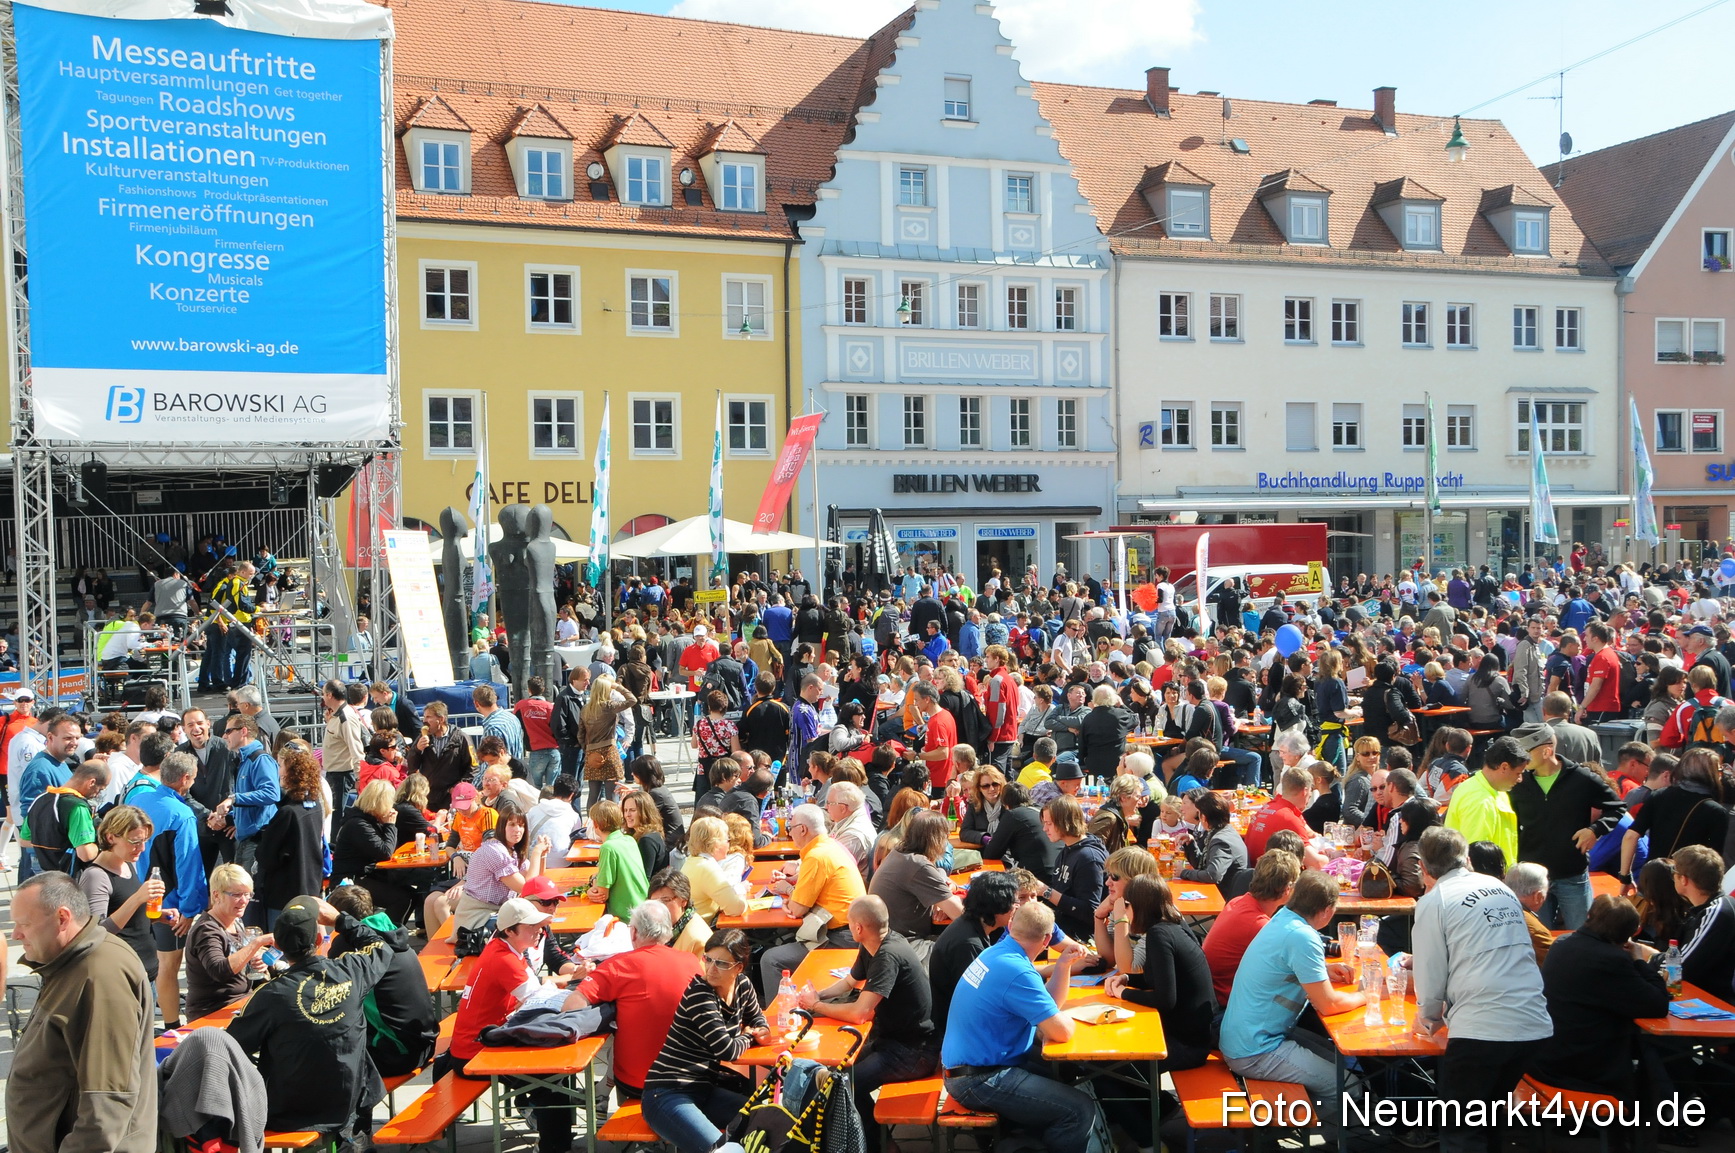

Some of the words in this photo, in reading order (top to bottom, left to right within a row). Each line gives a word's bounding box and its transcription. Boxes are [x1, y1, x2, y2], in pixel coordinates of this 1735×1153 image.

[92, 35, 316, 81] Messeauftritte
[59, 61, 269, 96] Hauptversammlungen
[274, 87, 293, 98] Get
[296, 88, 343, 102] together
[95, 91, 154, 106] Tagungen
[159, 92, 295, 121] Roadshows
[86, 110, 327, 148] Sportveranstaltungen
[63, 132, 256, 167] Installationen
[260, 156, 350, 171] TV-Produktionen
[86, 163, 269, 188] Kulturveranstaltungen
[118, 184, 197, 198] Fashionshows
[204, 190, 328, 206] Produktpräsentationen
[99, 198, 314, 229] Firmeneröffnungen
[129, 222, 218, 236] Firmenjubiläum
[215, 239, 284, 252] Firmenfeiern
[135, 244, 270, 273] Kongresse
[208, 273, 263, 286] Musicals
[150, 283, 250, 303] Konzerte
[176, 303, 237, 314] Tourservice
[131, 338, 299, 357] www.barowski-ag.de
[908, 351, 971, 369] BRILLEN
[973, 353, 1030, 370] WEBER
[154, 393, 284, 413] BAROWSKI
[292, 395, 327, 413] AG
[154, 415, 229, 424] Veranstaltungs-
[232, 415, 251, 423] und
[254, 415, 326, 424] Mediensysteme
[1139, 424, 1153, 446] R
[893, 474, 968, 493] BRILLEN
[972, 474, 1042, 492] WEBER
[1258, 472, 1378, 492] Buchhandlung
[1384, 472, 1463, 492] Ruppecht
[981, 528, 1007, 536] BRILLEN
[1009, 528, 1034, 536] WEBER
[1130, 557, 1136, 568] A
[1312, 570, 1320, 584] A
[1461, 892, 1480, 908] TSV
